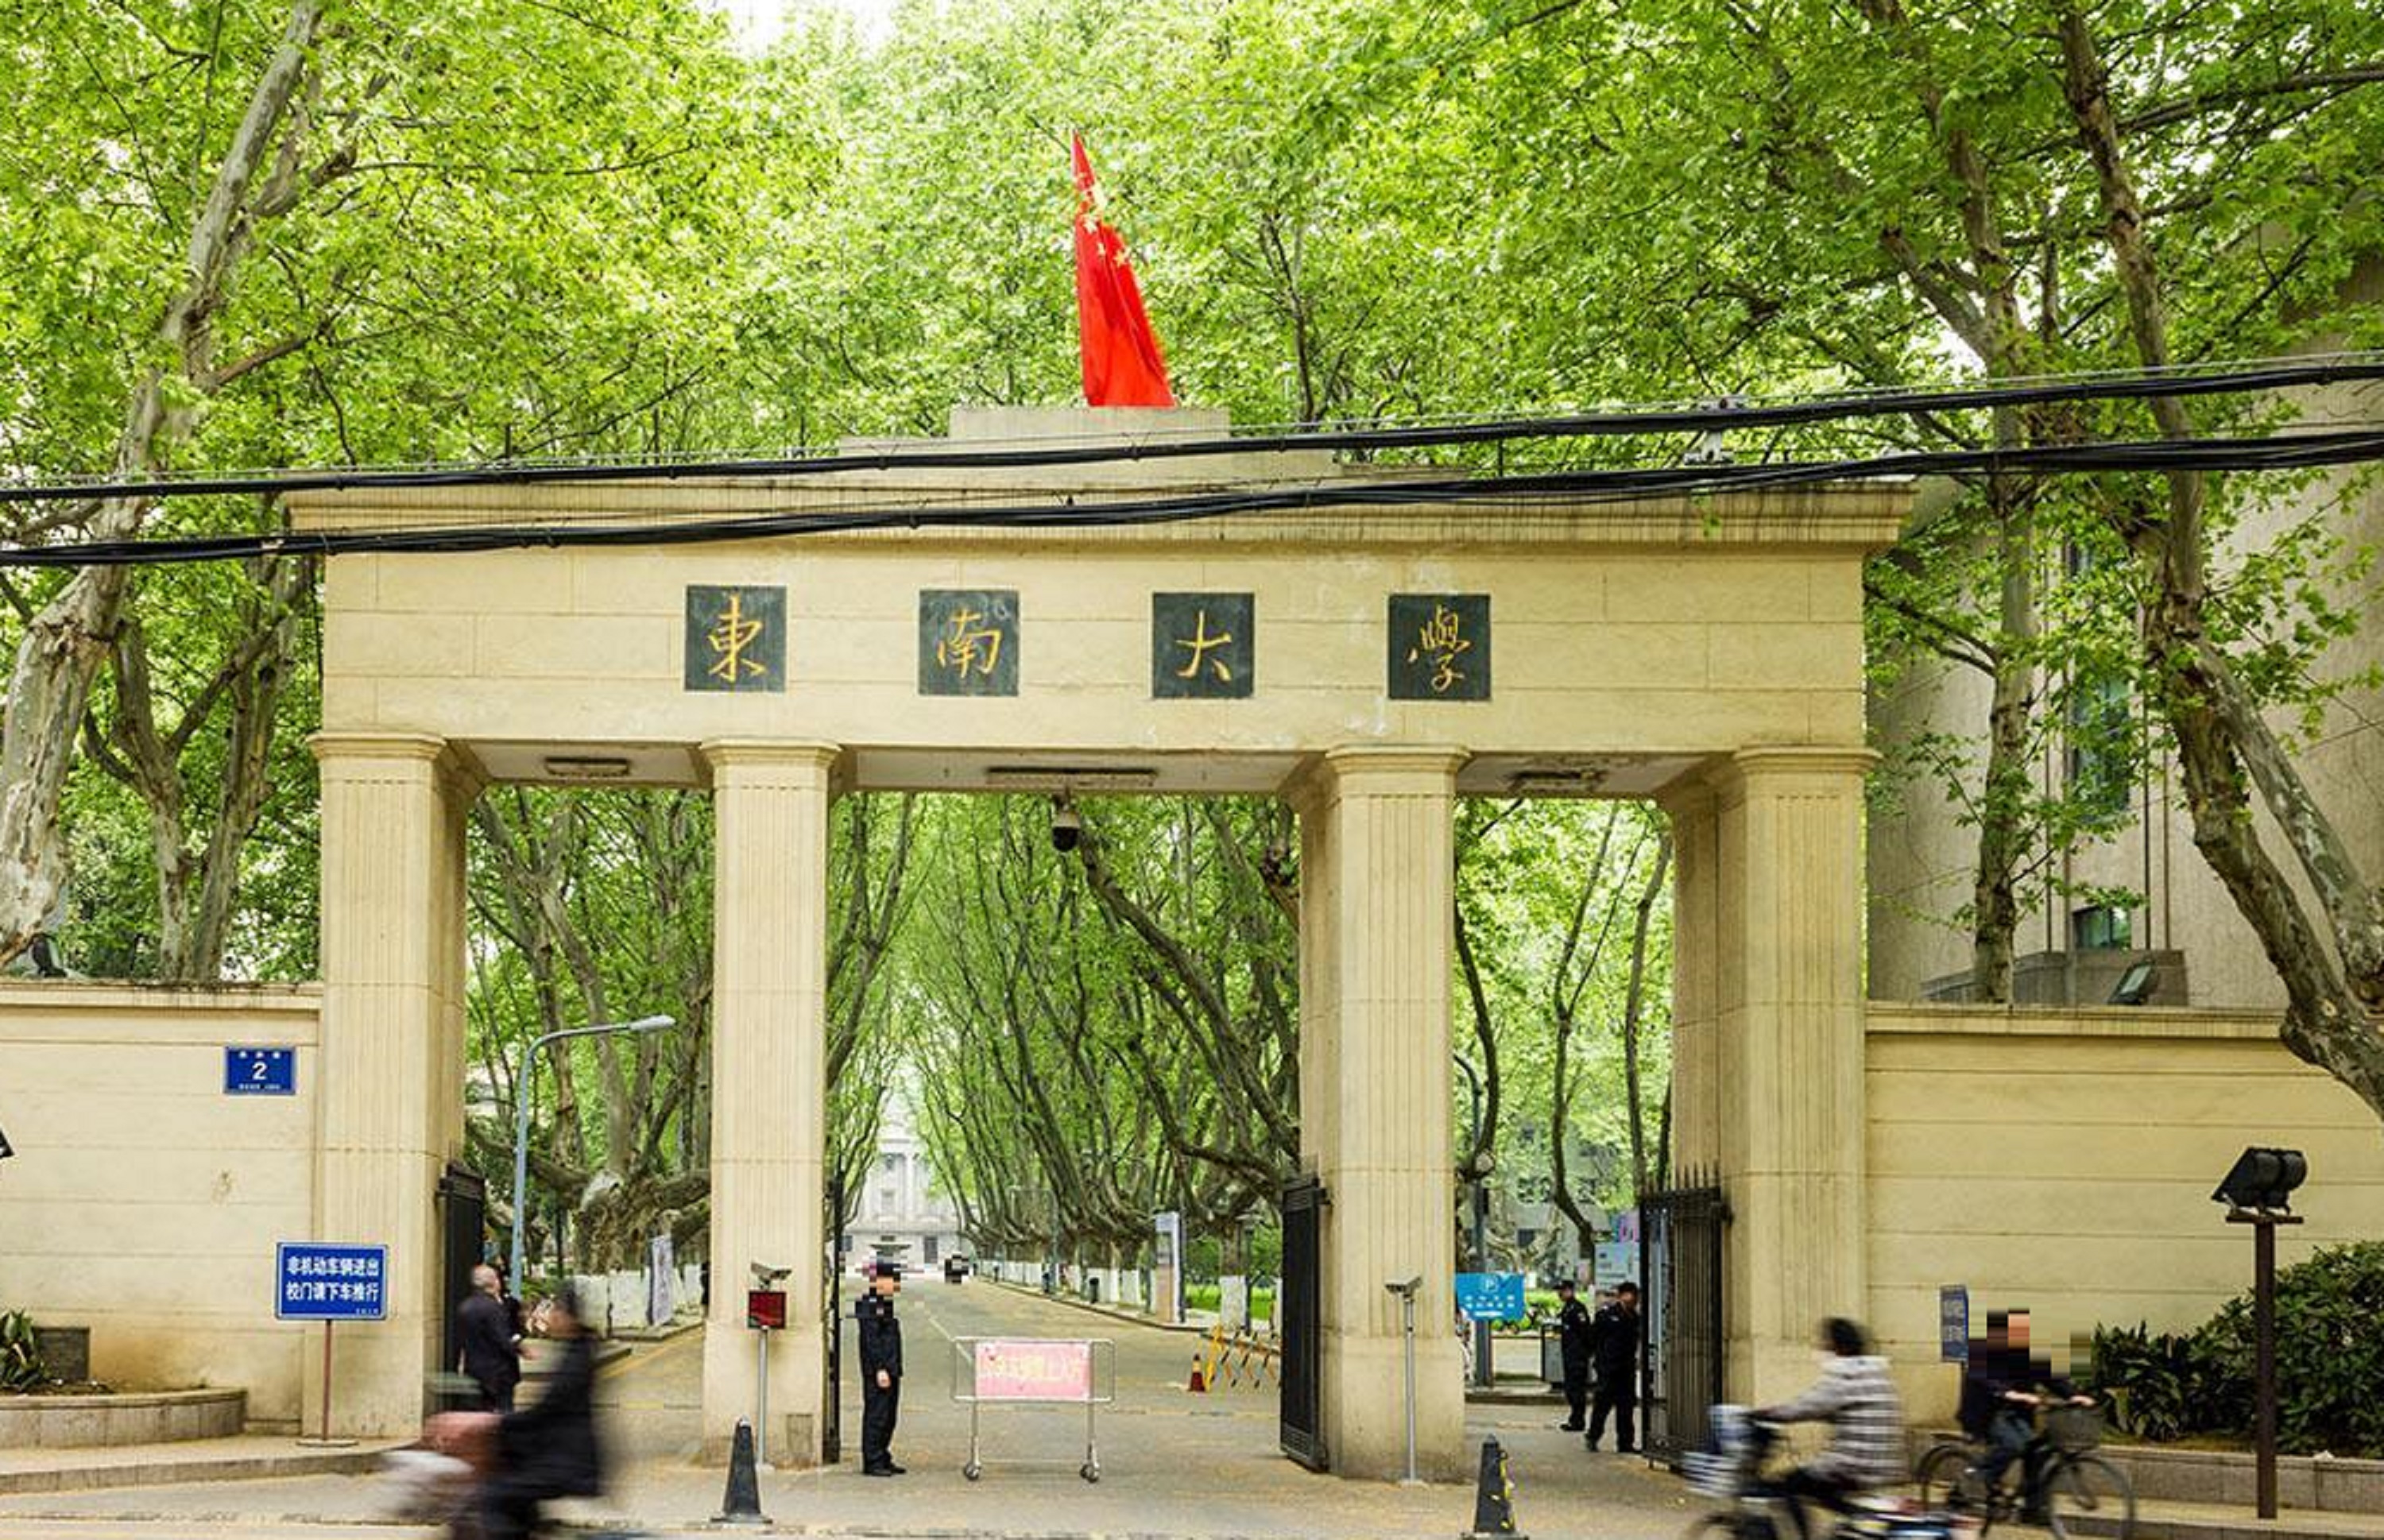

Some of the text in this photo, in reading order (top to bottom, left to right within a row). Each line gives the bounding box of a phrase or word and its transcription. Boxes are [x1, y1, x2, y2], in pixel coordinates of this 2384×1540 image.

[252, 1061, 268, 1081] 2
[286, 1256, 379, 1276] 非机动车辆进出
[285, 1280, 379, 1302] 校门请下车推行
